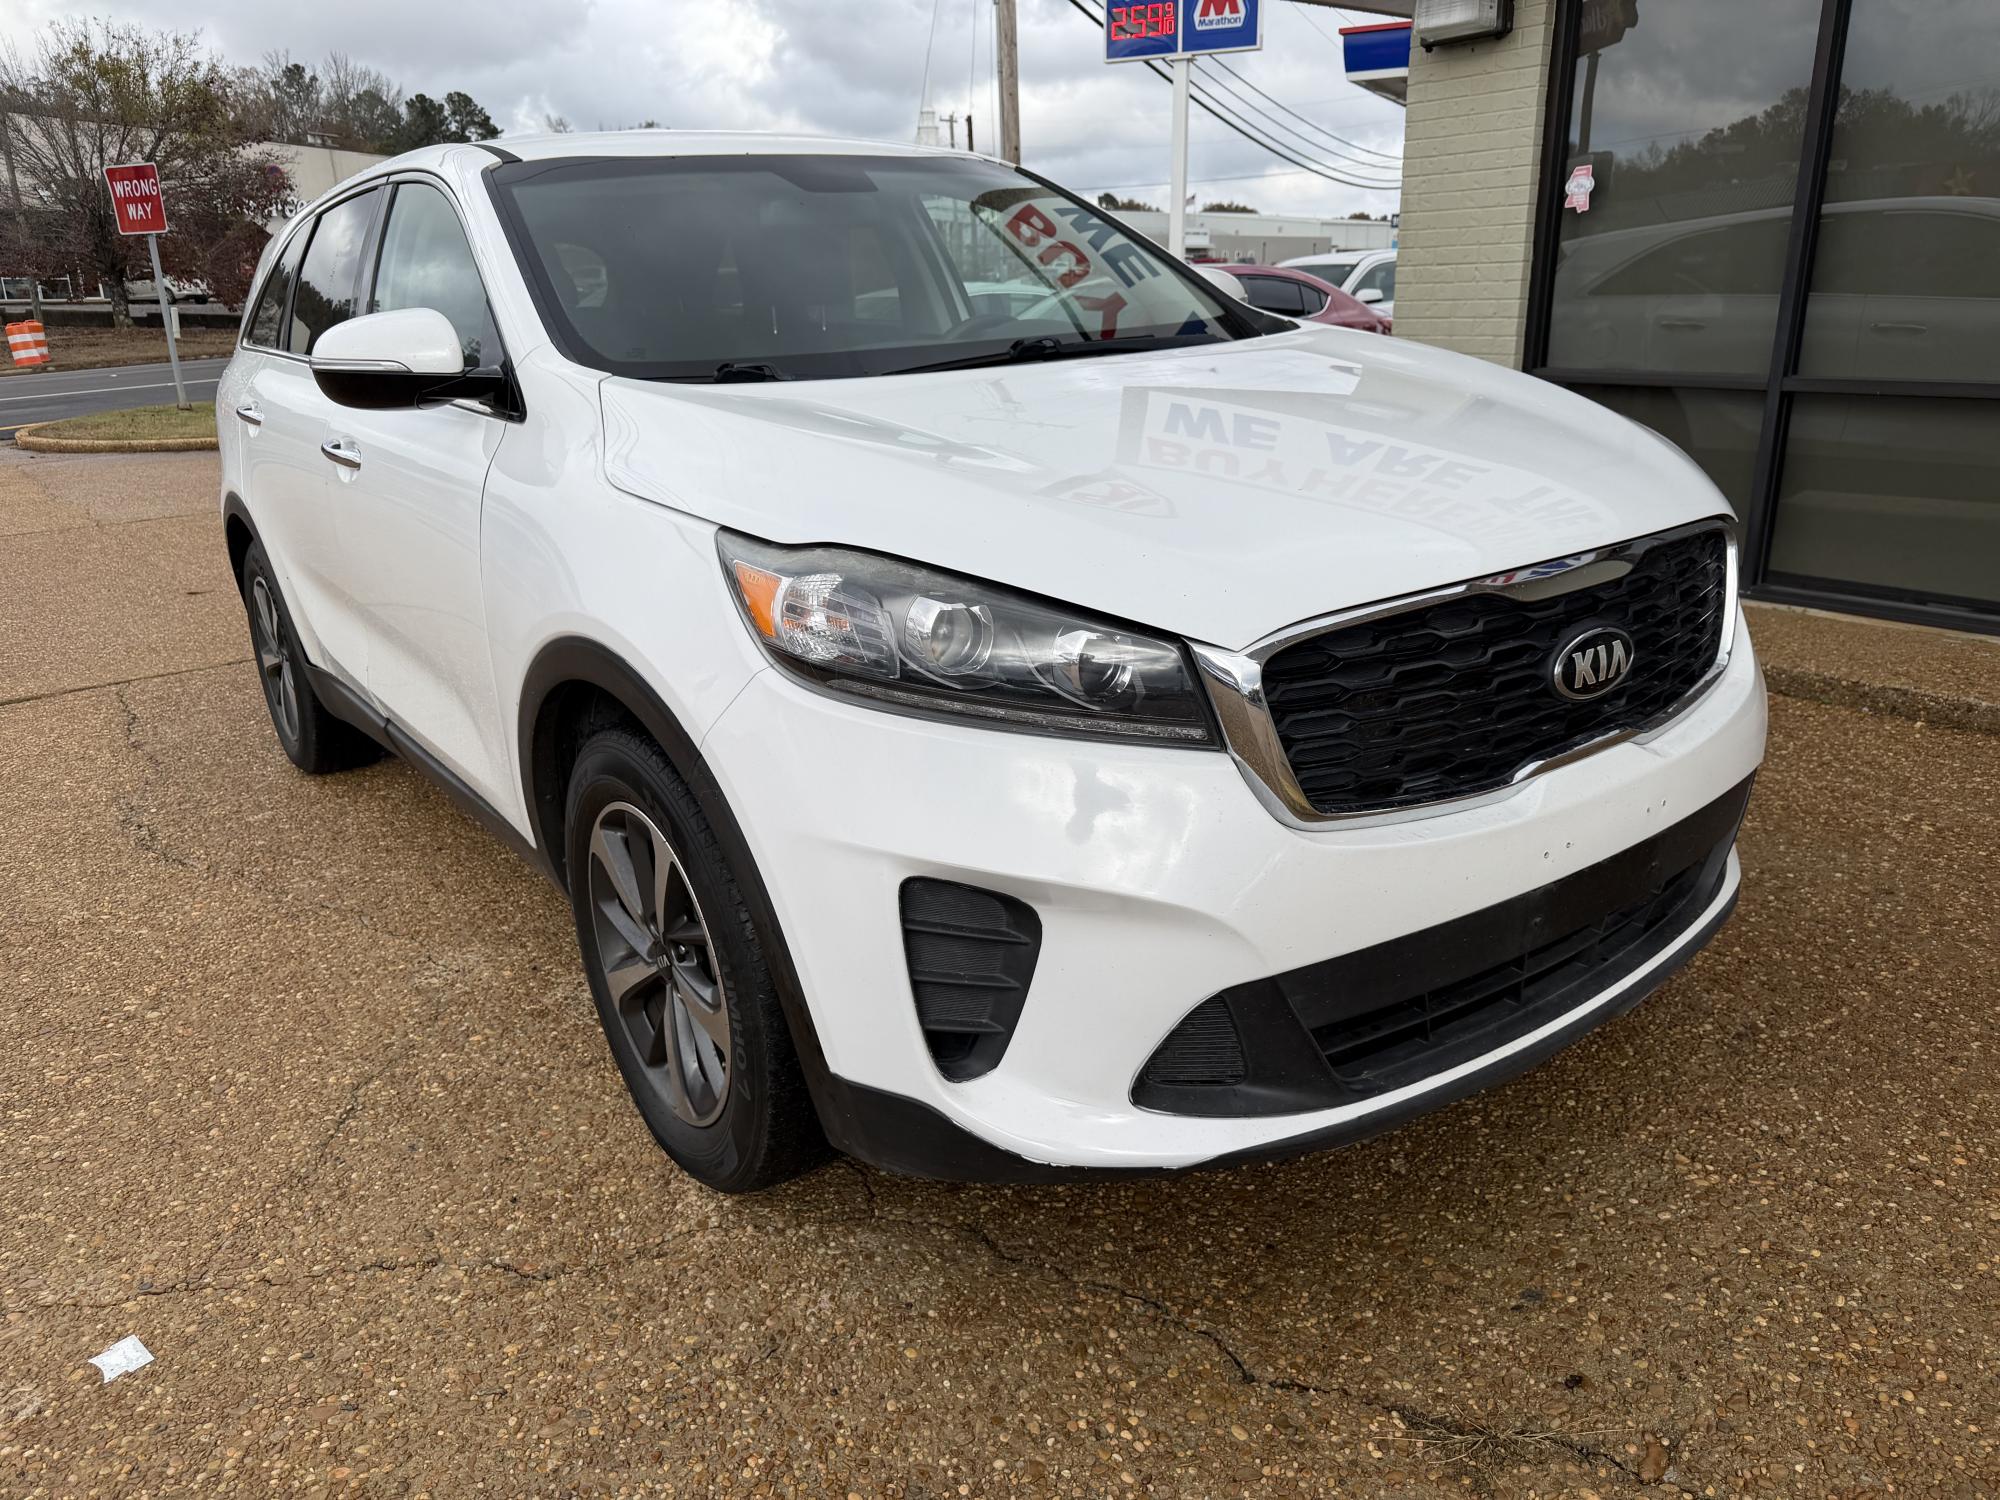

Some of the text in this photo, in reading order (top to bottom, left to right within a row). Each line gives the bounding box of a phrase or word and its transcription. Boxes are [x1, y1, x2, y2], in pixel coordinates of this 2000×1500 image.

[1198, 16, 1242, 27] Marathon
[113, 178, 158, 198] WRONG
[126, 202, 153, 220] WAY
[1571, 639, 1627, 690] KIA
